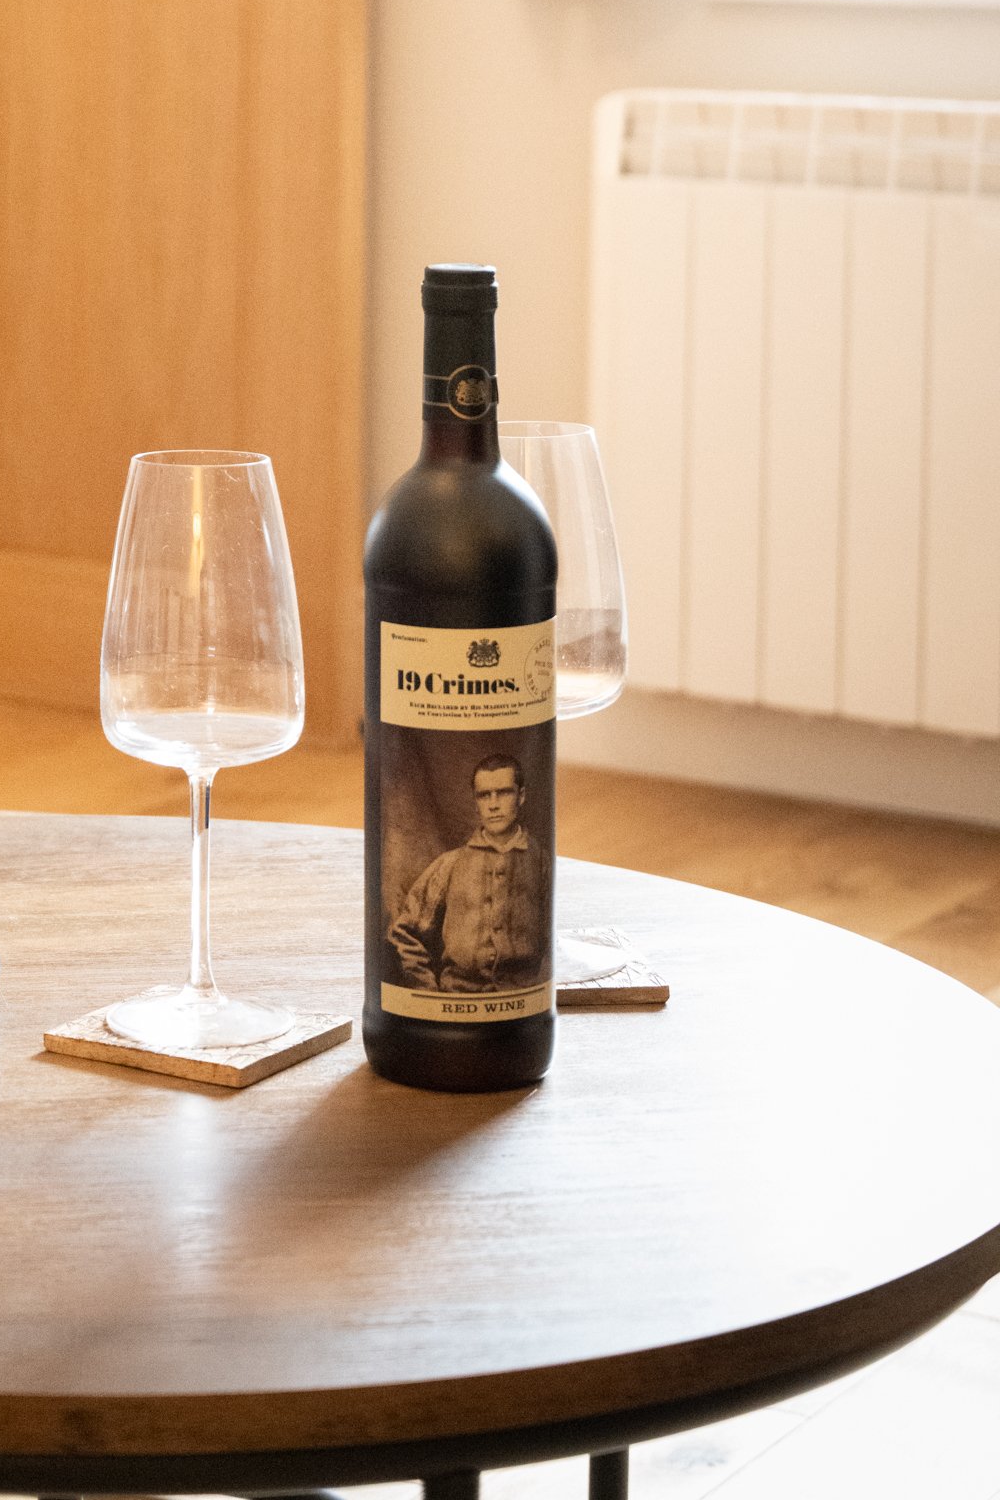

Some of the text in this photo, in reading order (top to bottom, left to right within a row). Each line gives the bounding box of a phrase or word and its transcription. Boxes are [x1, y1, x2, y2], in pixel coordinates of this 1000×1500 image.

[397, 669, 421, 691] 19
[425, 672, 520, 695] Crimes.
[441, 999, 526, 1013] RED WINE
